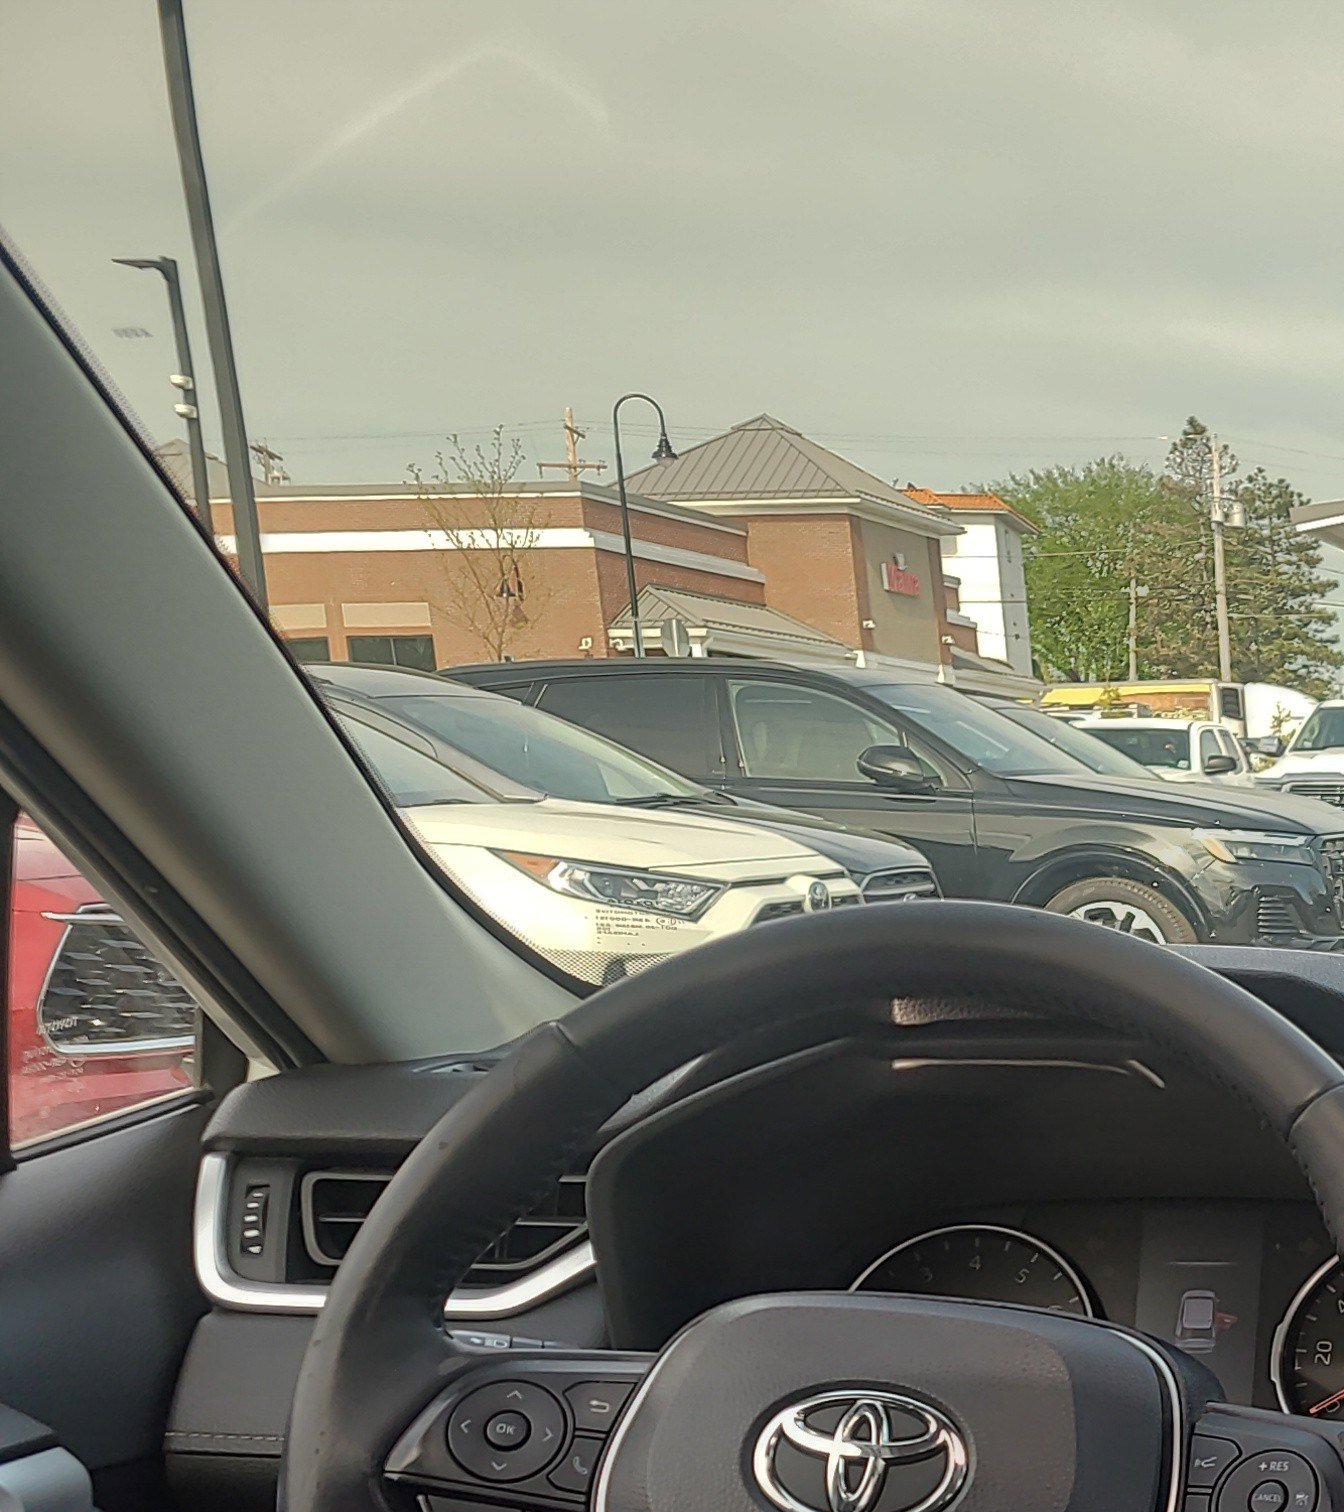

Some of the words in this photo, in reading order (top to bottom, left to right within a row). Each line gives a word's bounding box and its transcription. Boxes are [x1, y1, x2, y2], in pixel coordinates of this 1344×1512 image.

[968, 1255, 983, 1272] 4
[1015, 1267, 1031, 1285] 5
[1313, 1339, 1333, 1367] 20
[495, 1423, 518, 1436] OK
[1253, 1493, 1283, 1504] CANCEL
